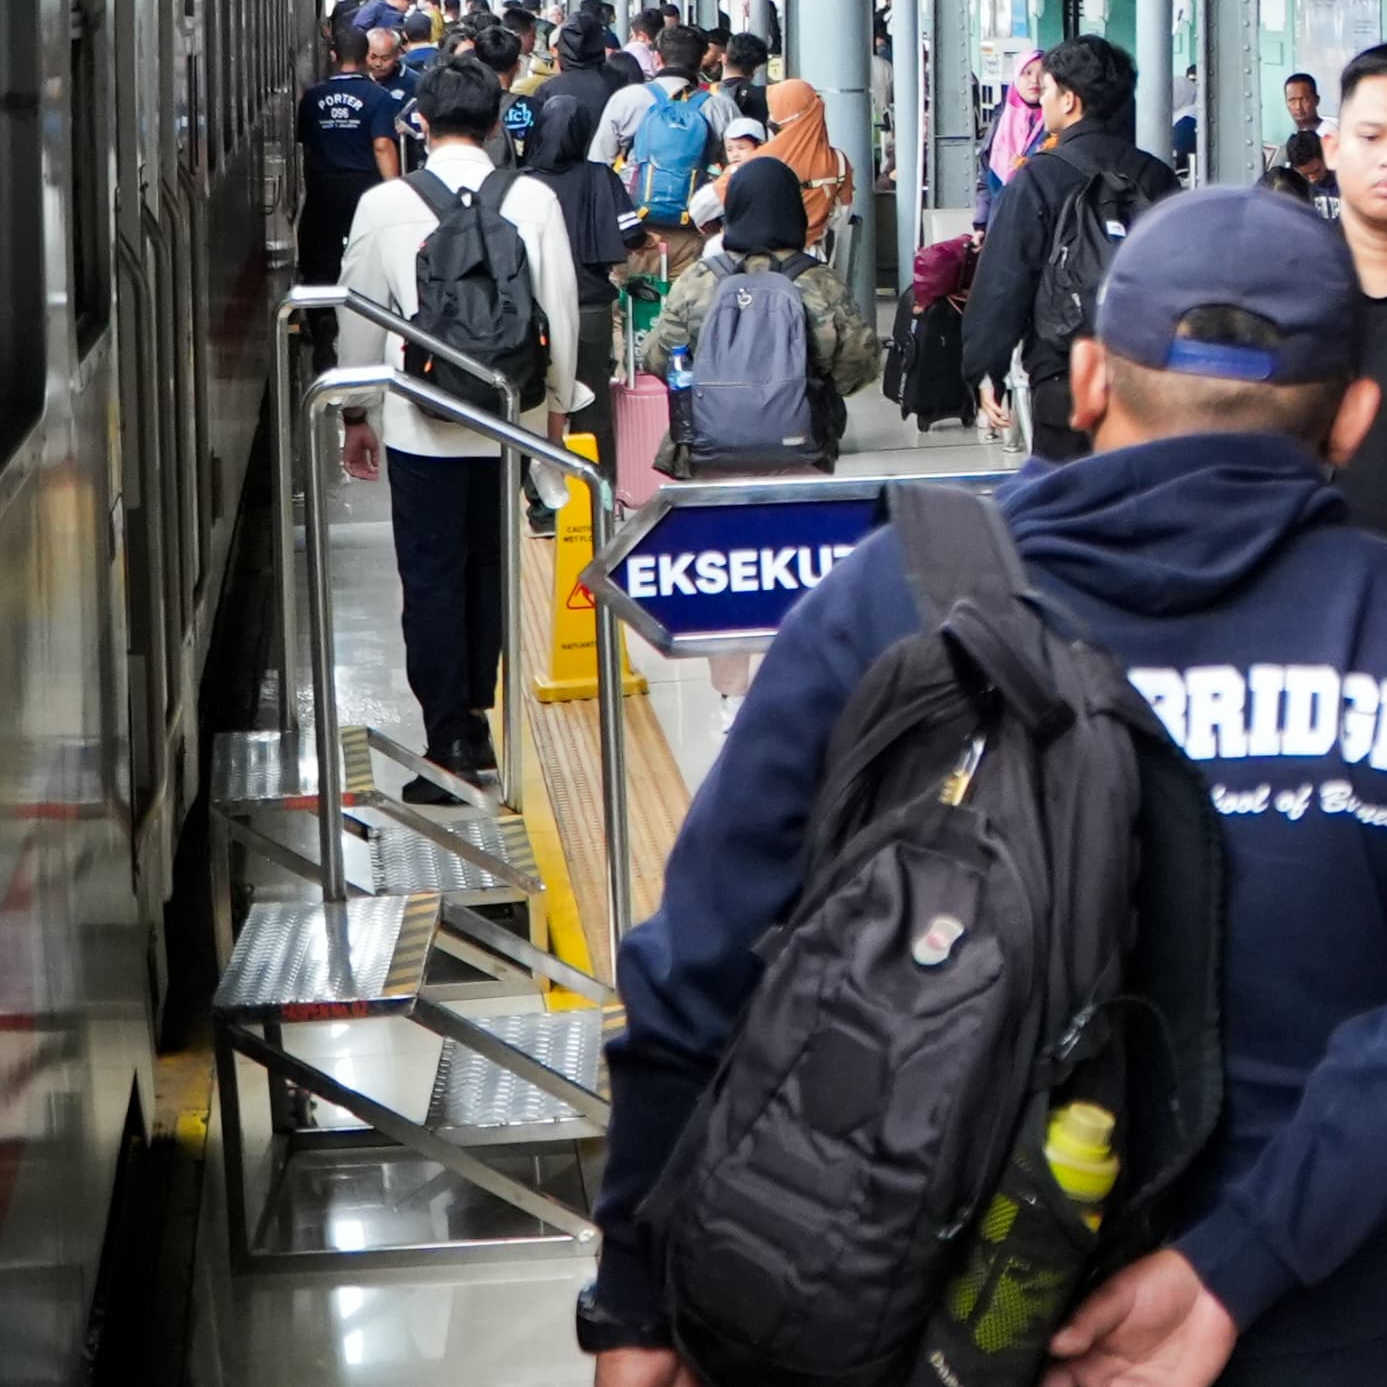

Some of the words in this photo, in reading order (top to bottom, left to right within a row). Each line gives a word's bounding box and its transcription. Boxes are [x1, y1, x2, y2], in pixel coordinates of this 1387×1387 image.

[318, 93, 363, 111] PORTER
[330, 107, 350, 119] 096
[1274, 783, 1314, 822] of
